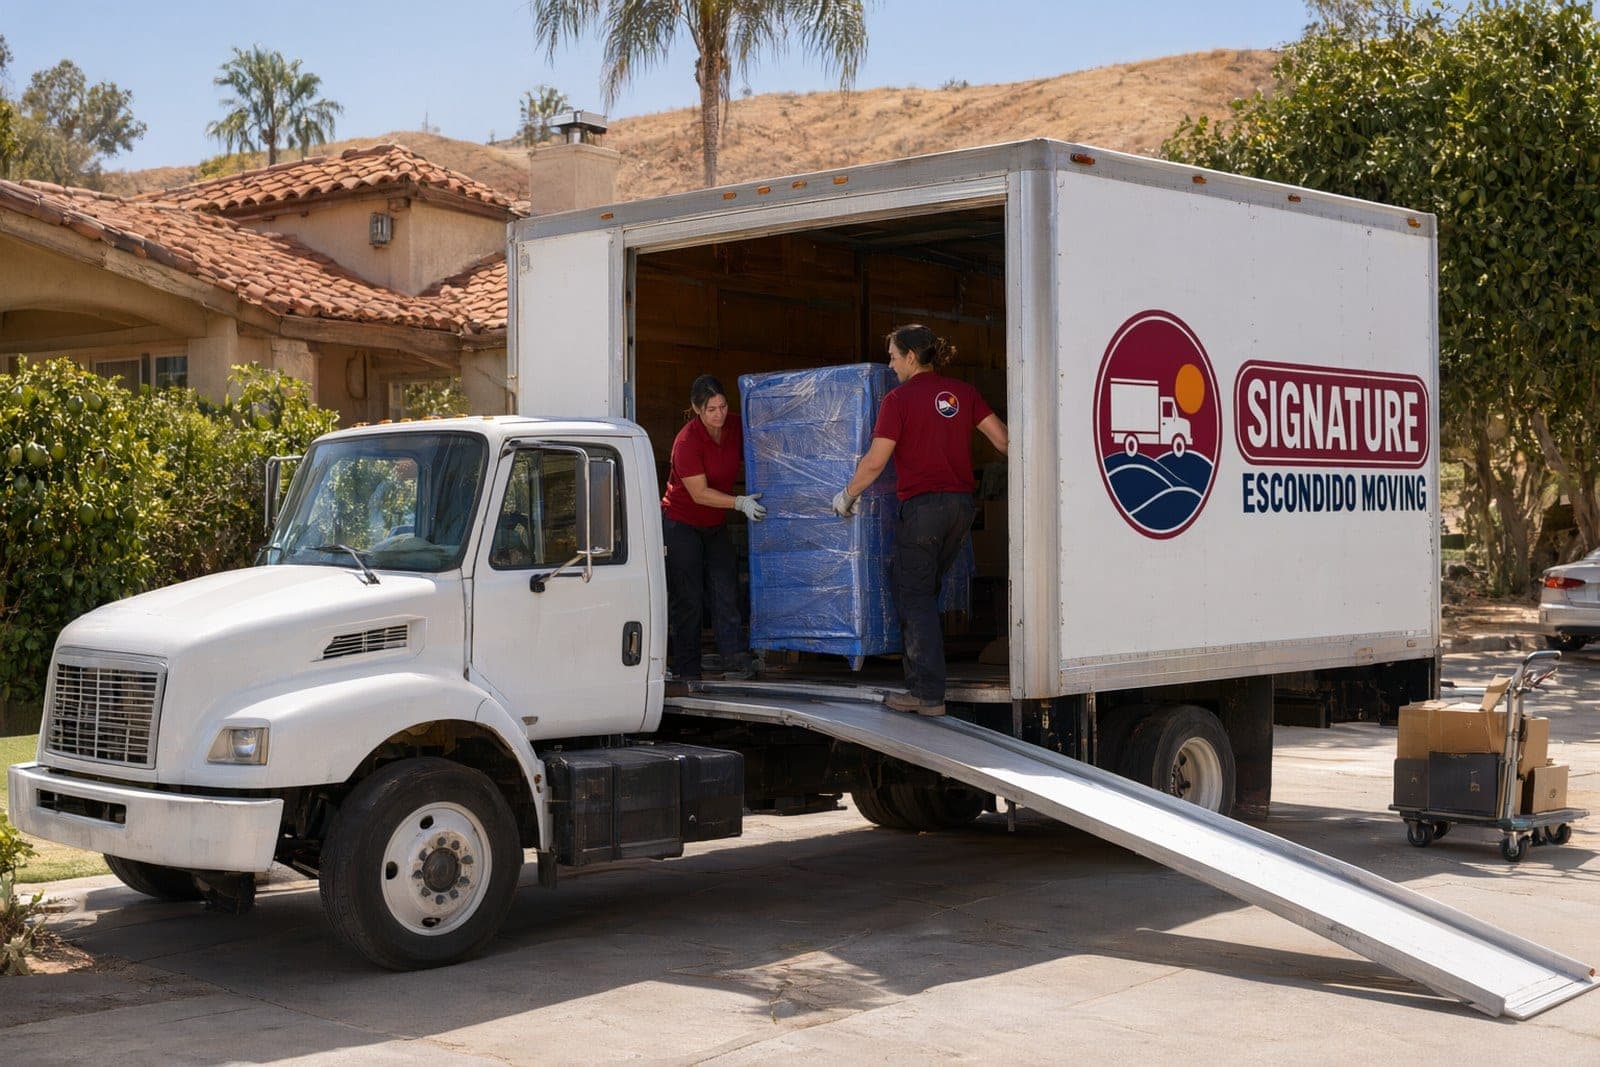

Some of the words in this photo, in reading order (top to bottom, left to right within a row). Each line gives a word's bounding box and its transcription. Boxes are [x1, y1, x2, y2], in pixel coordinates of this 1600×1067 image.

[1247, 378, 1419, 452] SIGNATURE
[1242, 472, 1356, 513] ESCONDIDO
[1361, 474, 1426, 512] MOVING
